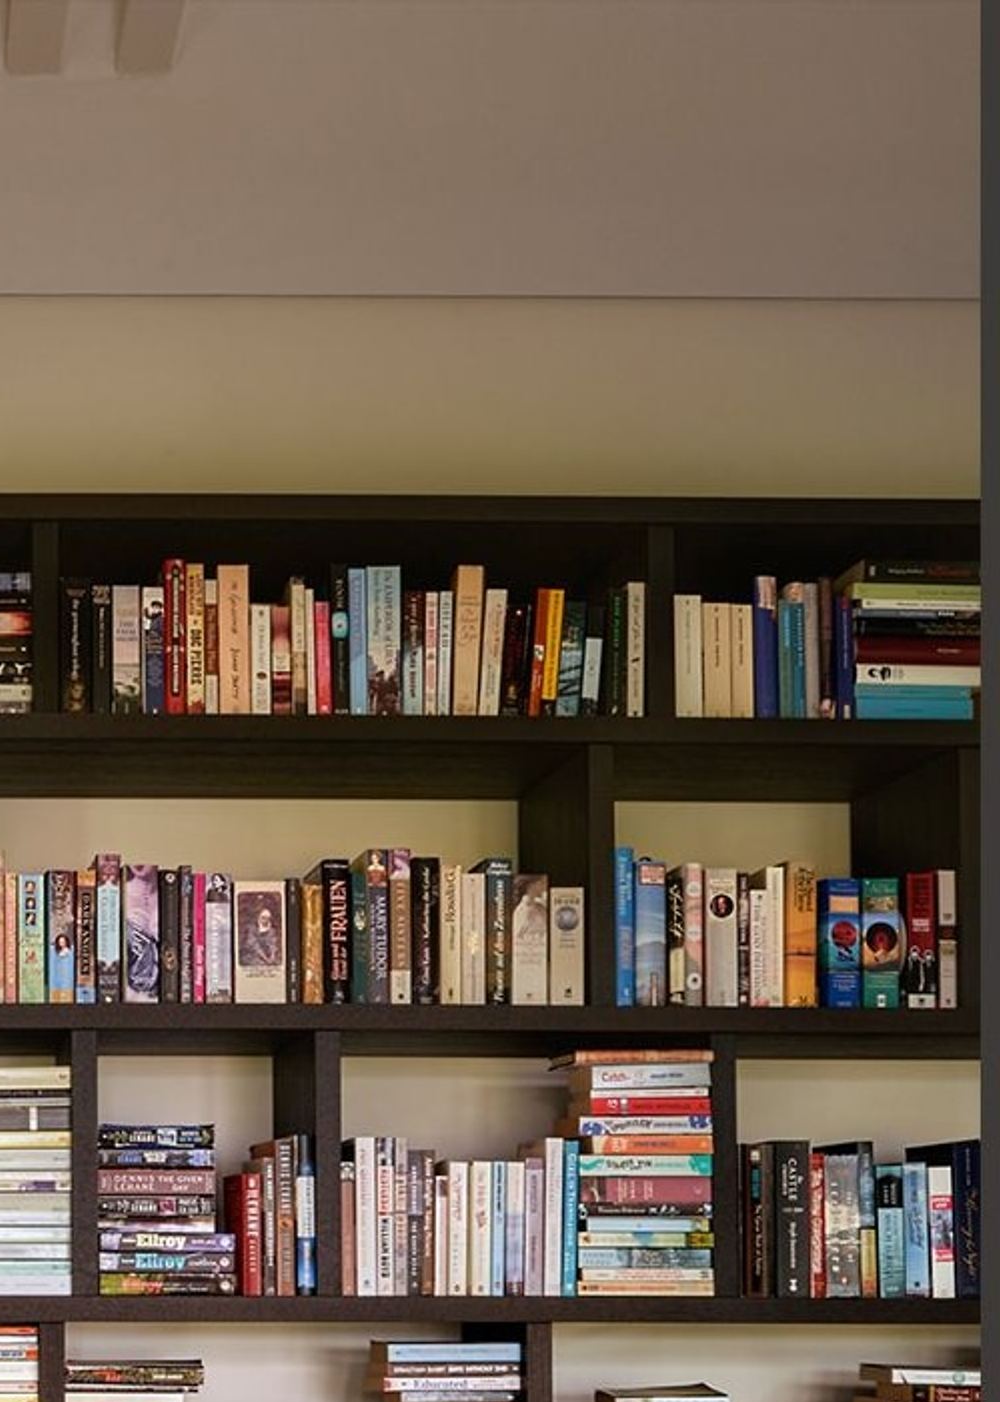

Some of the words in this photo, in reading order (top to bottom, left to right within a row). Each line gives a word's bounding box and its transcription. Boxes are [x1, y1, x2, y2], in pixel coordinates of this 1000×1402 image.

[81, 895, 90, 926] DARK
[330, 879, 348, 942] FRAUEN
[376, 896, 386, 930] MARY
[81, 930, 90, 974] ANGELS
[375, 935, 386, 980] TUDOR
[398, 916, 406, 967] SISTERS
[280, 1145, 292, 1178] DENNIS
[788, 1158, 798, 1201] CASTLE
[136, 1233, 186, 1249] Ellroy
[381, 1219, 390, 1254] WILLIAM
[135, 1253, 186, 1269] Ellroy
[381, 1255, 390, 1278] BOYD
[413, 1380, 468, 1389] Educated
